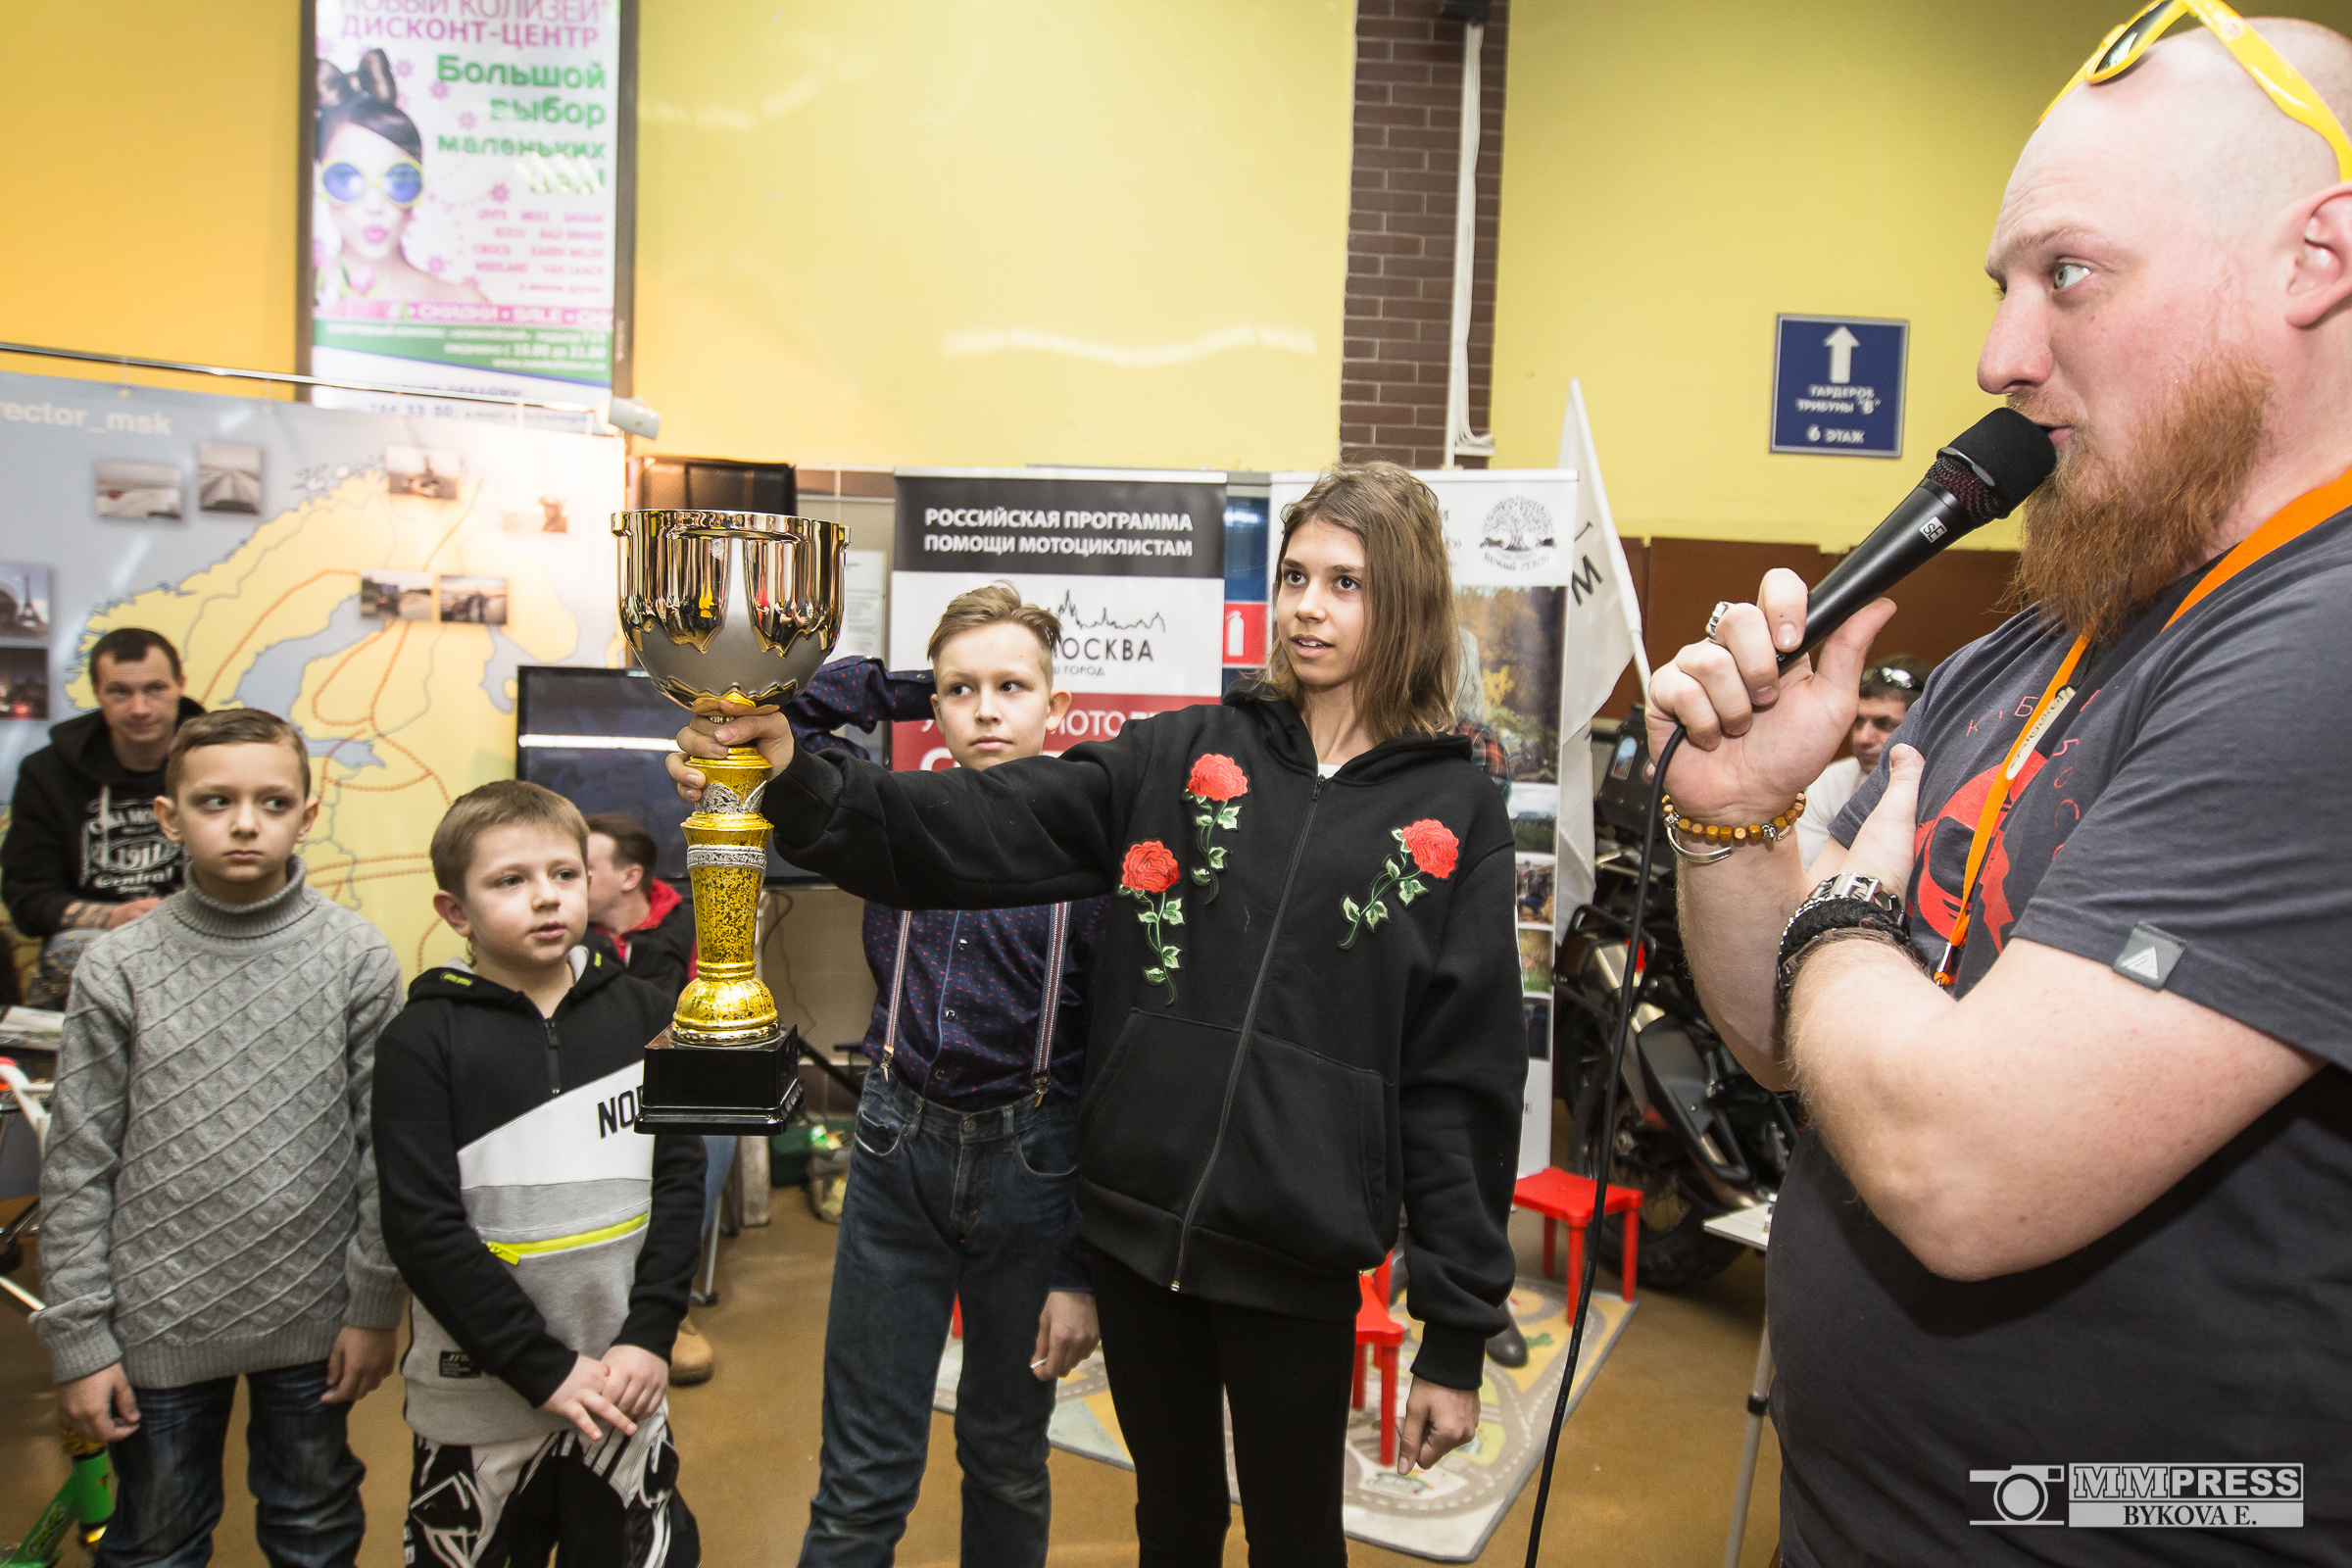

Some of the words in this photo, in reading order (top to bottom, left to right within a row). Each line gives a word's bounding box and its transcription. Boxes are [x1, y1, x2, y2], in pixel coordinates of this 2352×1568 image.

[341, 15, 600, 50] ДИСКОНТ-ЦЕНТР
[437, 54, 606, 89] Большой
[437, 134, 606, 159] маленьких
[1809, 384, 1875, 400] ГАРДЕРОБ
[0, 401, 172, 436] ector_msk
[1795, 398, 1854, 414] ТРИБУНЫ
[1807, 424, 1821, 442] 6
[1824, 427, 1865, 444] ЭТАЖ
[925, 506, 1060, 528] РОССИЙСКАЯ
[1064, 511, 1193, 531] ПРОГРАММА
[924, 534, 1015, 556] ПОМОЩИ
[1019, 536, 1193, 557] МОТОЦИКЛИСТАМ
[118, 843, 162, 869] 1911
